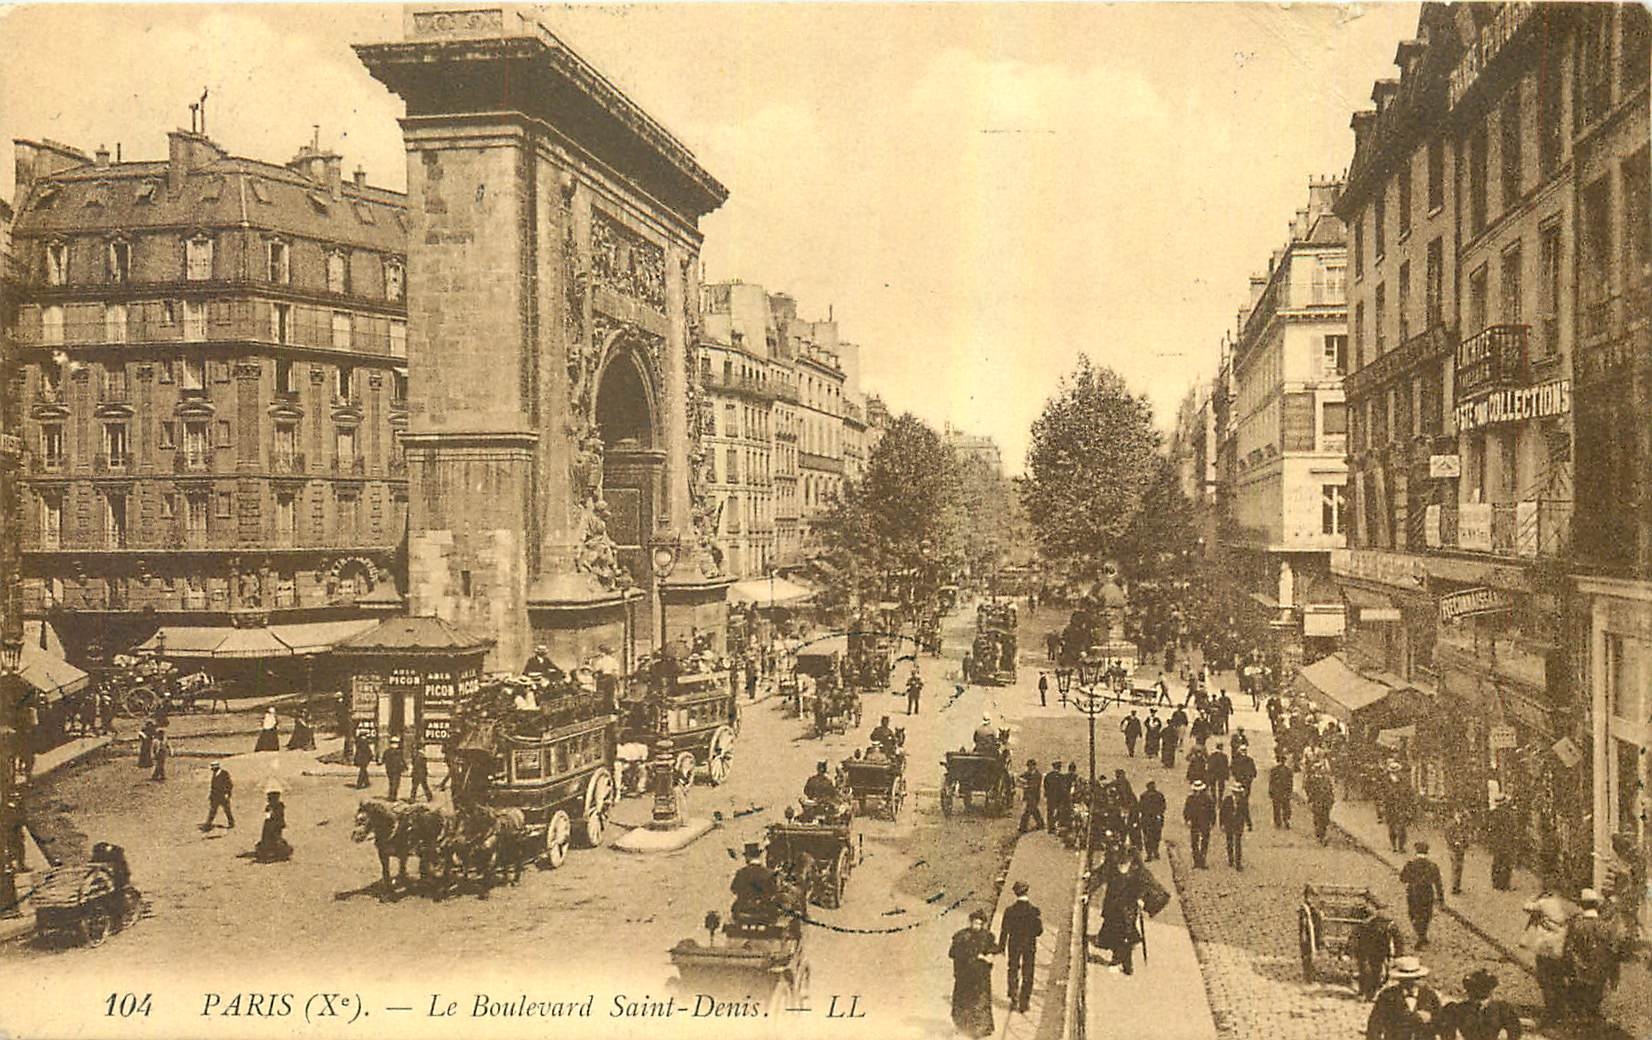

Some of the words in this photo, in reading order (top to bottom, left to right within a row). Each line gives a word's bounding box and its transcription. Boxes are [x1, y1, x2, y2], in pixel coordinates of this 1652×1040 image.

[1489, 381, 1570, 422] COLLECTIONS
[389, 676, 420, 685] PICON
[425, 684, 454, 697] PICON
